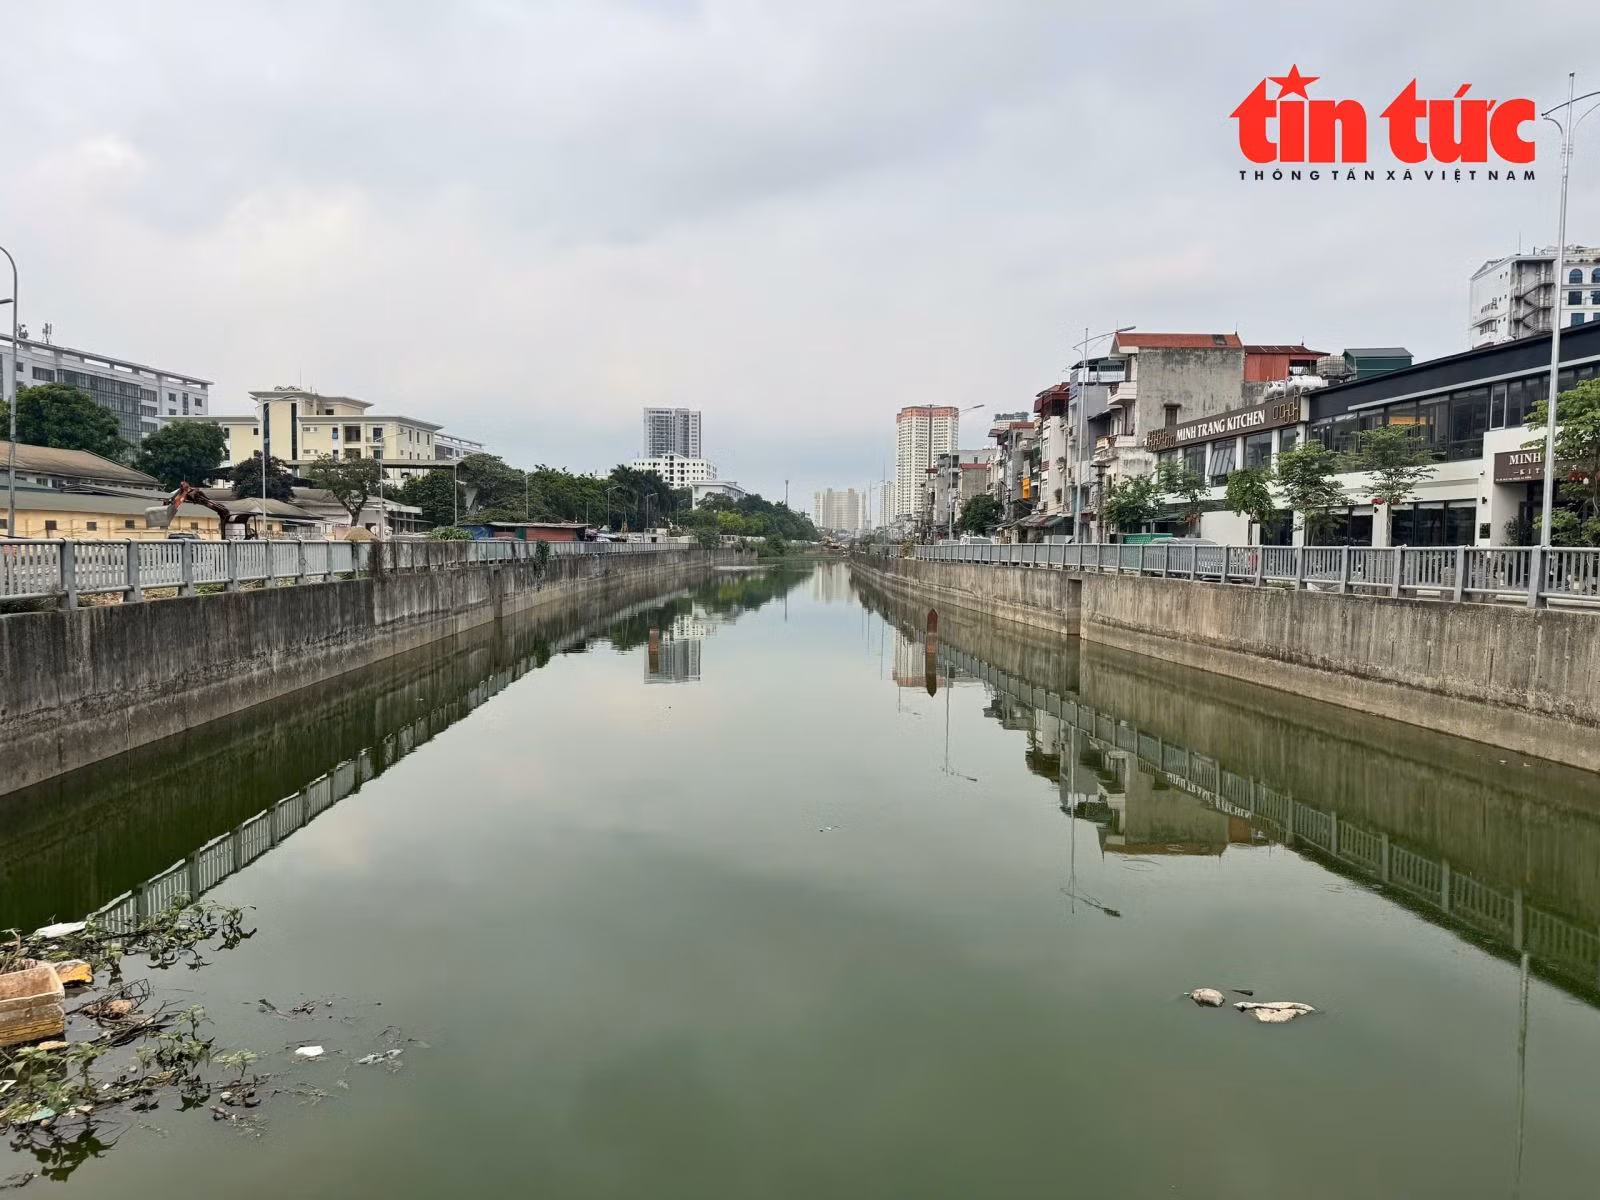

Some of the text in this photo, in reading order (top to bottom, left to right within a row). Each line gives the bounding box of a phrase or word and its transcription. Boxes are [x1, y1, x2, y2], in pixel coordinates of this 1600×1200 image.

[1176, 409, 1265, 442] MINH TRANG KITCHEN
[1509, 452, 1541, 465] MINH
